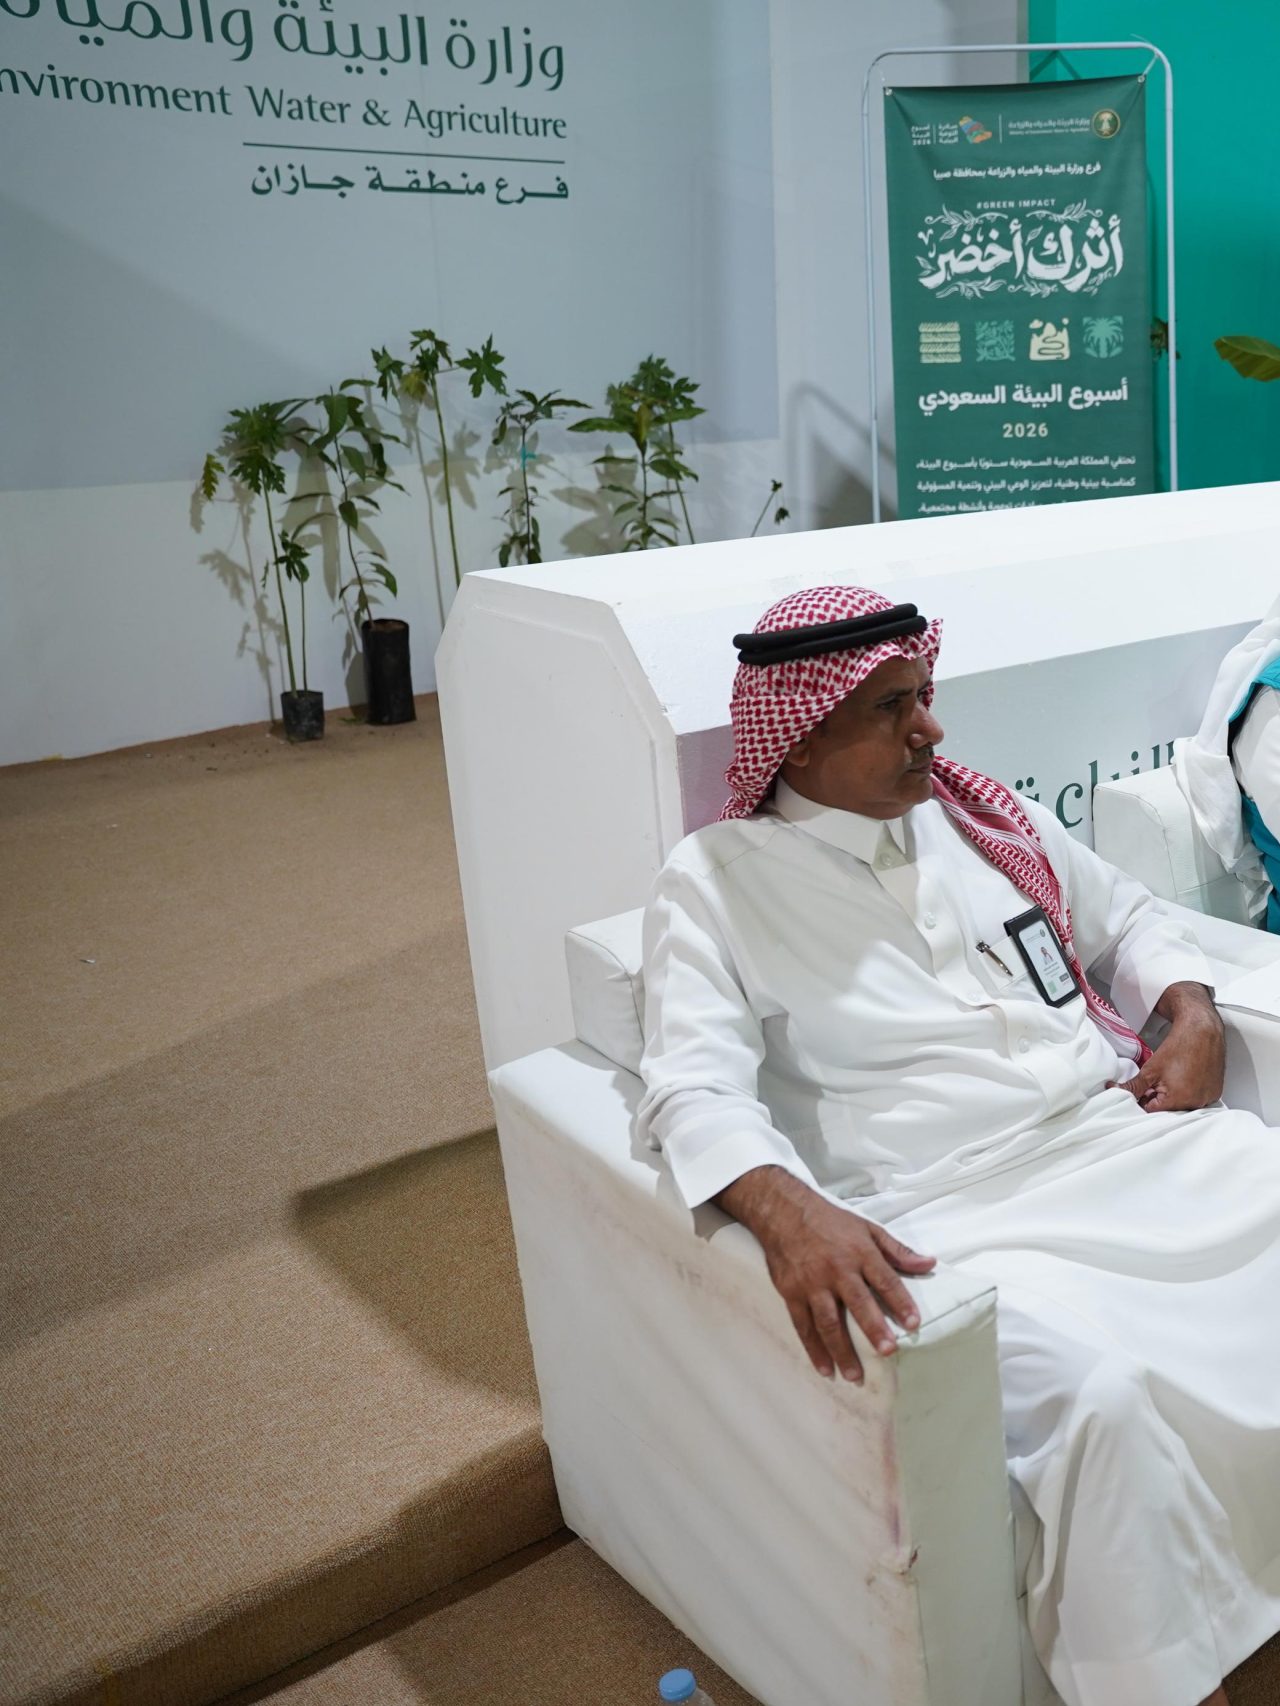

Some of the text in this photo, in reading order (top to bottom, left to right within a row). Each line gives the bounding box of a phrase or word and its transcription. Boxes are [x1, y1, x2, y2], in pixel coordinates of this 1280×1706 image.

[273, 0, 429, 76] البيئة
[445, 18, 565, 91] وزارة
[0, 64, 567, 138] nvironment Water & Agriculture
[933, 161, 1101, 180] فرع وزارة البيئة والمياه والزراعة بمحافظة صبيا
[251, 163, 569, 205] فرع منطقة جازان
[1019, 199, 1056, 208] IMPACT
[918, 217, 1025, 290] أخضر
[918, 377, 1129, 416] أسبوع البيئة السعودي
[1002, 423, 1048, 438] 2026
[1009, 456, 1052, 469] السعودية
[1053, 456, 1079, 468] العربية
[1080, 456, 1109, 465] المملكة
[917, 480, 956, 492] المسؤولية
[983, 479, 1006, 493] البيئي
[1008, 479, 1029, 493] الوعي
